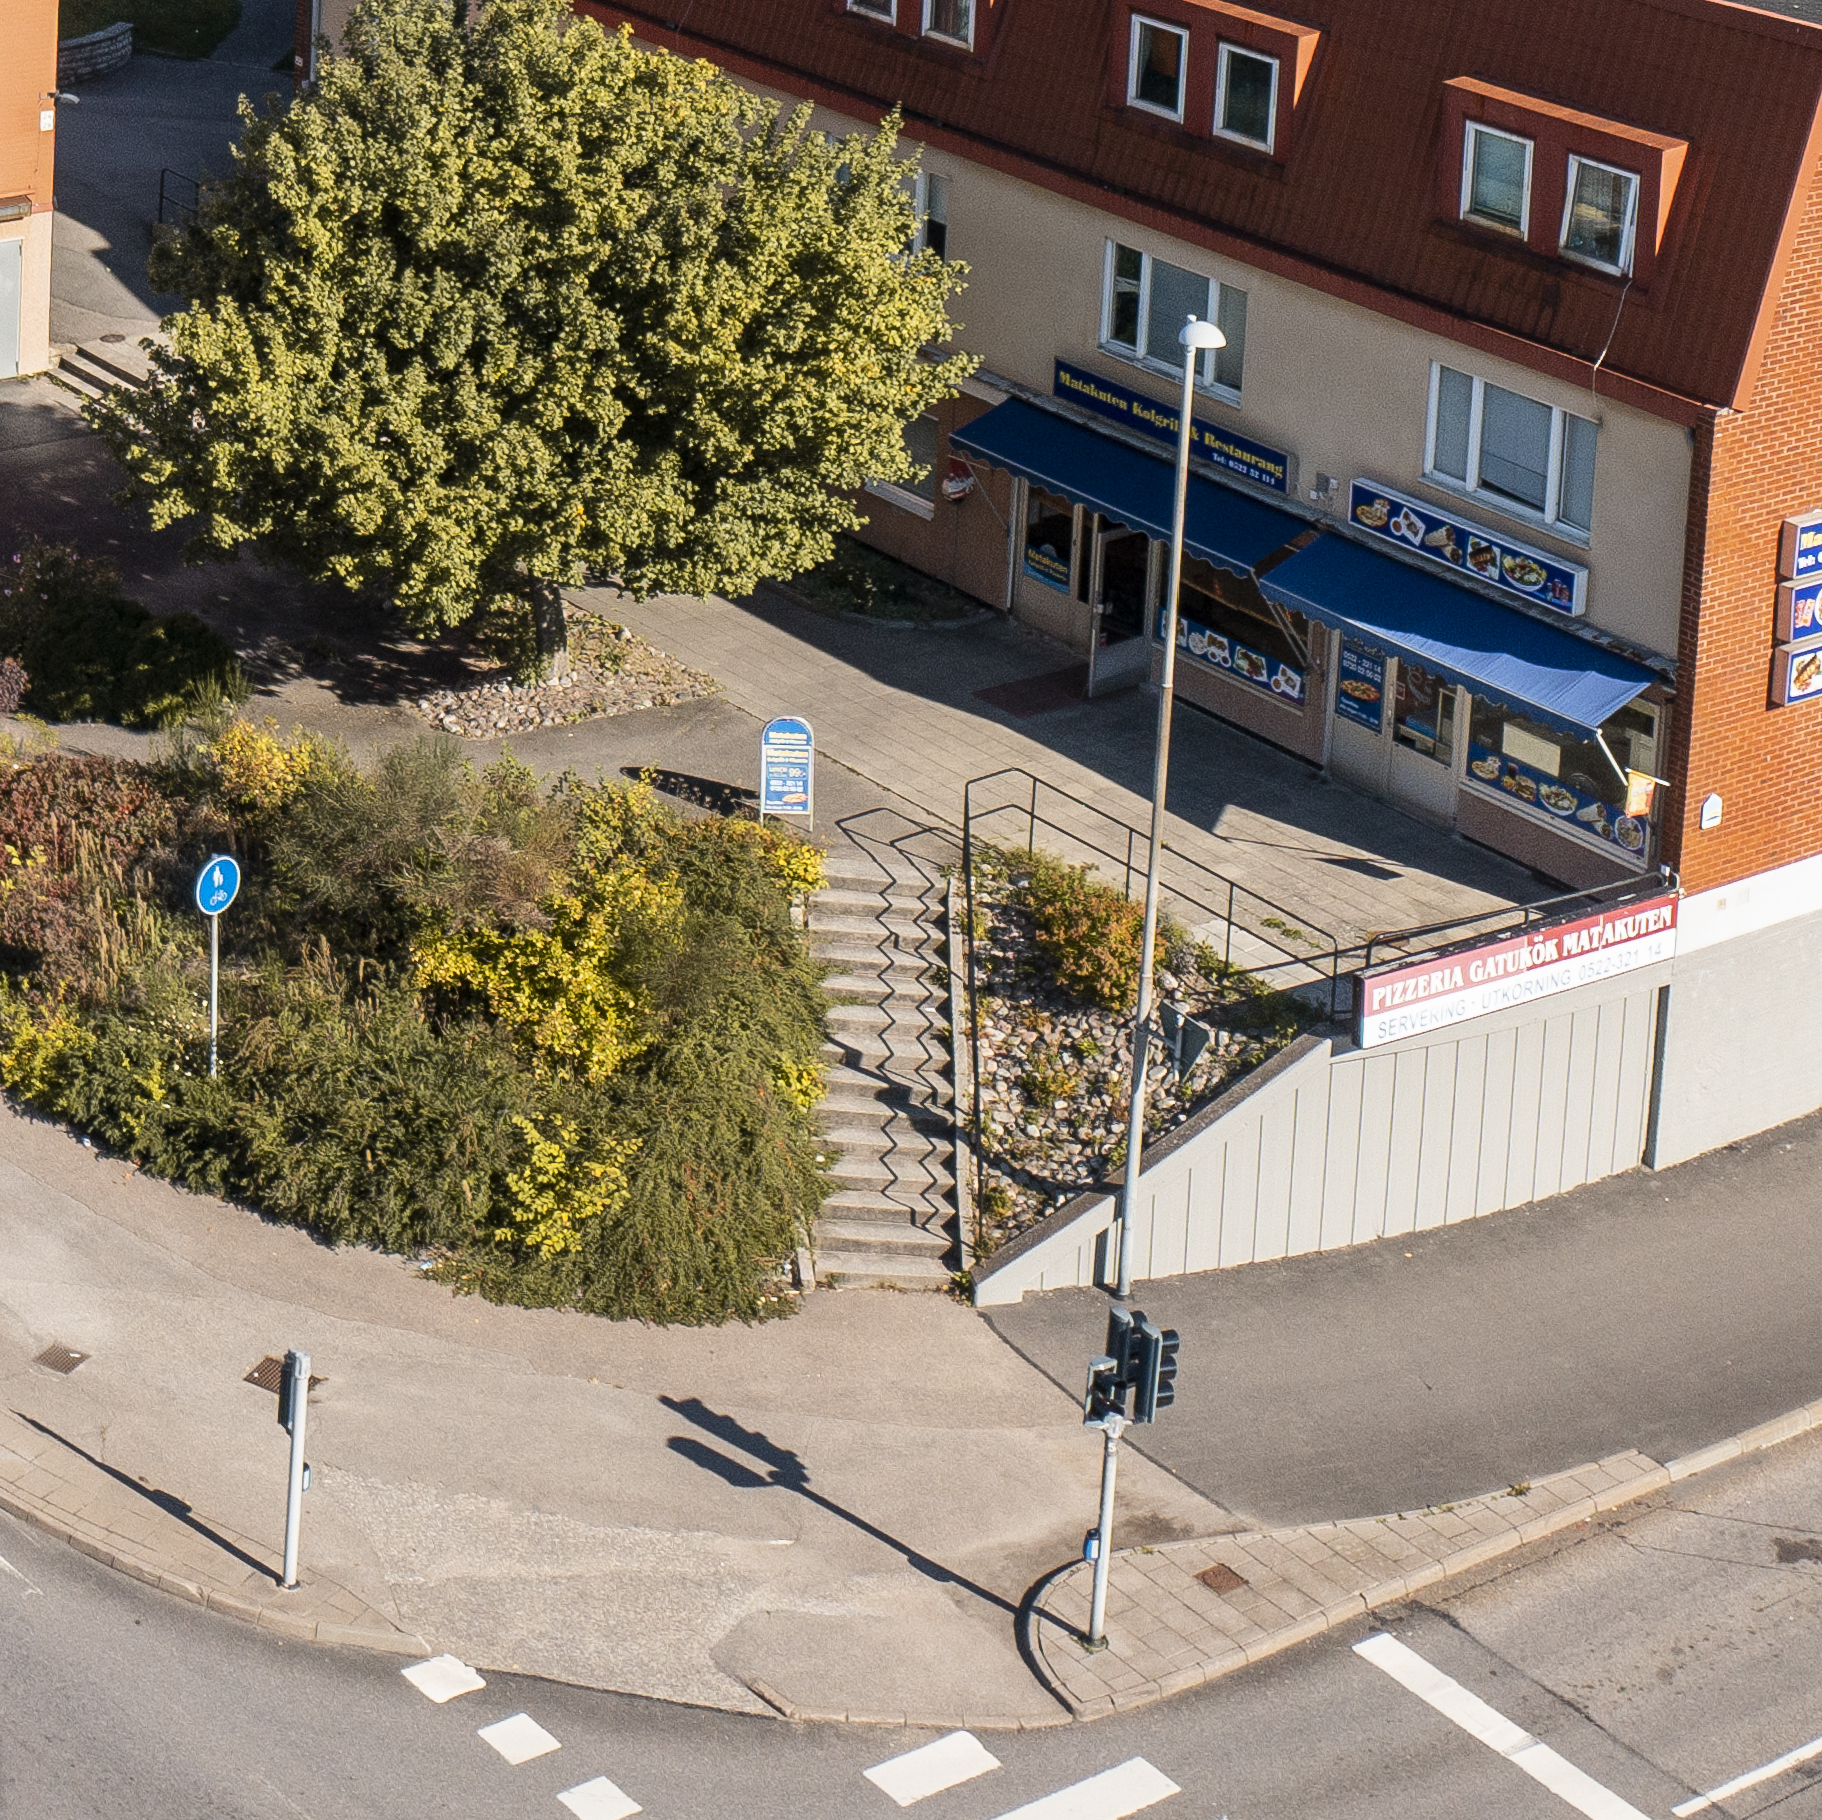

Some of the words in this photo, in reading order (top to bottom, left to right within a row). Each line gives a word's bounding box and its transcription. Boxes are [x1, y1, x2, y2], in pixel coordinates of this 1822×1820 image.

[1059, 370, 1128, 411] Matakuten
[1132, 402, 1179, 432] Kolgril
[1204, 432, 1283, 479] Restaurang
[1372, 965, 1464, 1012] PIZZERIA
[1470, 935, 1559, 983] GATUKÖK
[1563, 905, 1673, 957] MATAKUTEN
[1378, 998, 1466, 1040] SERVERING
